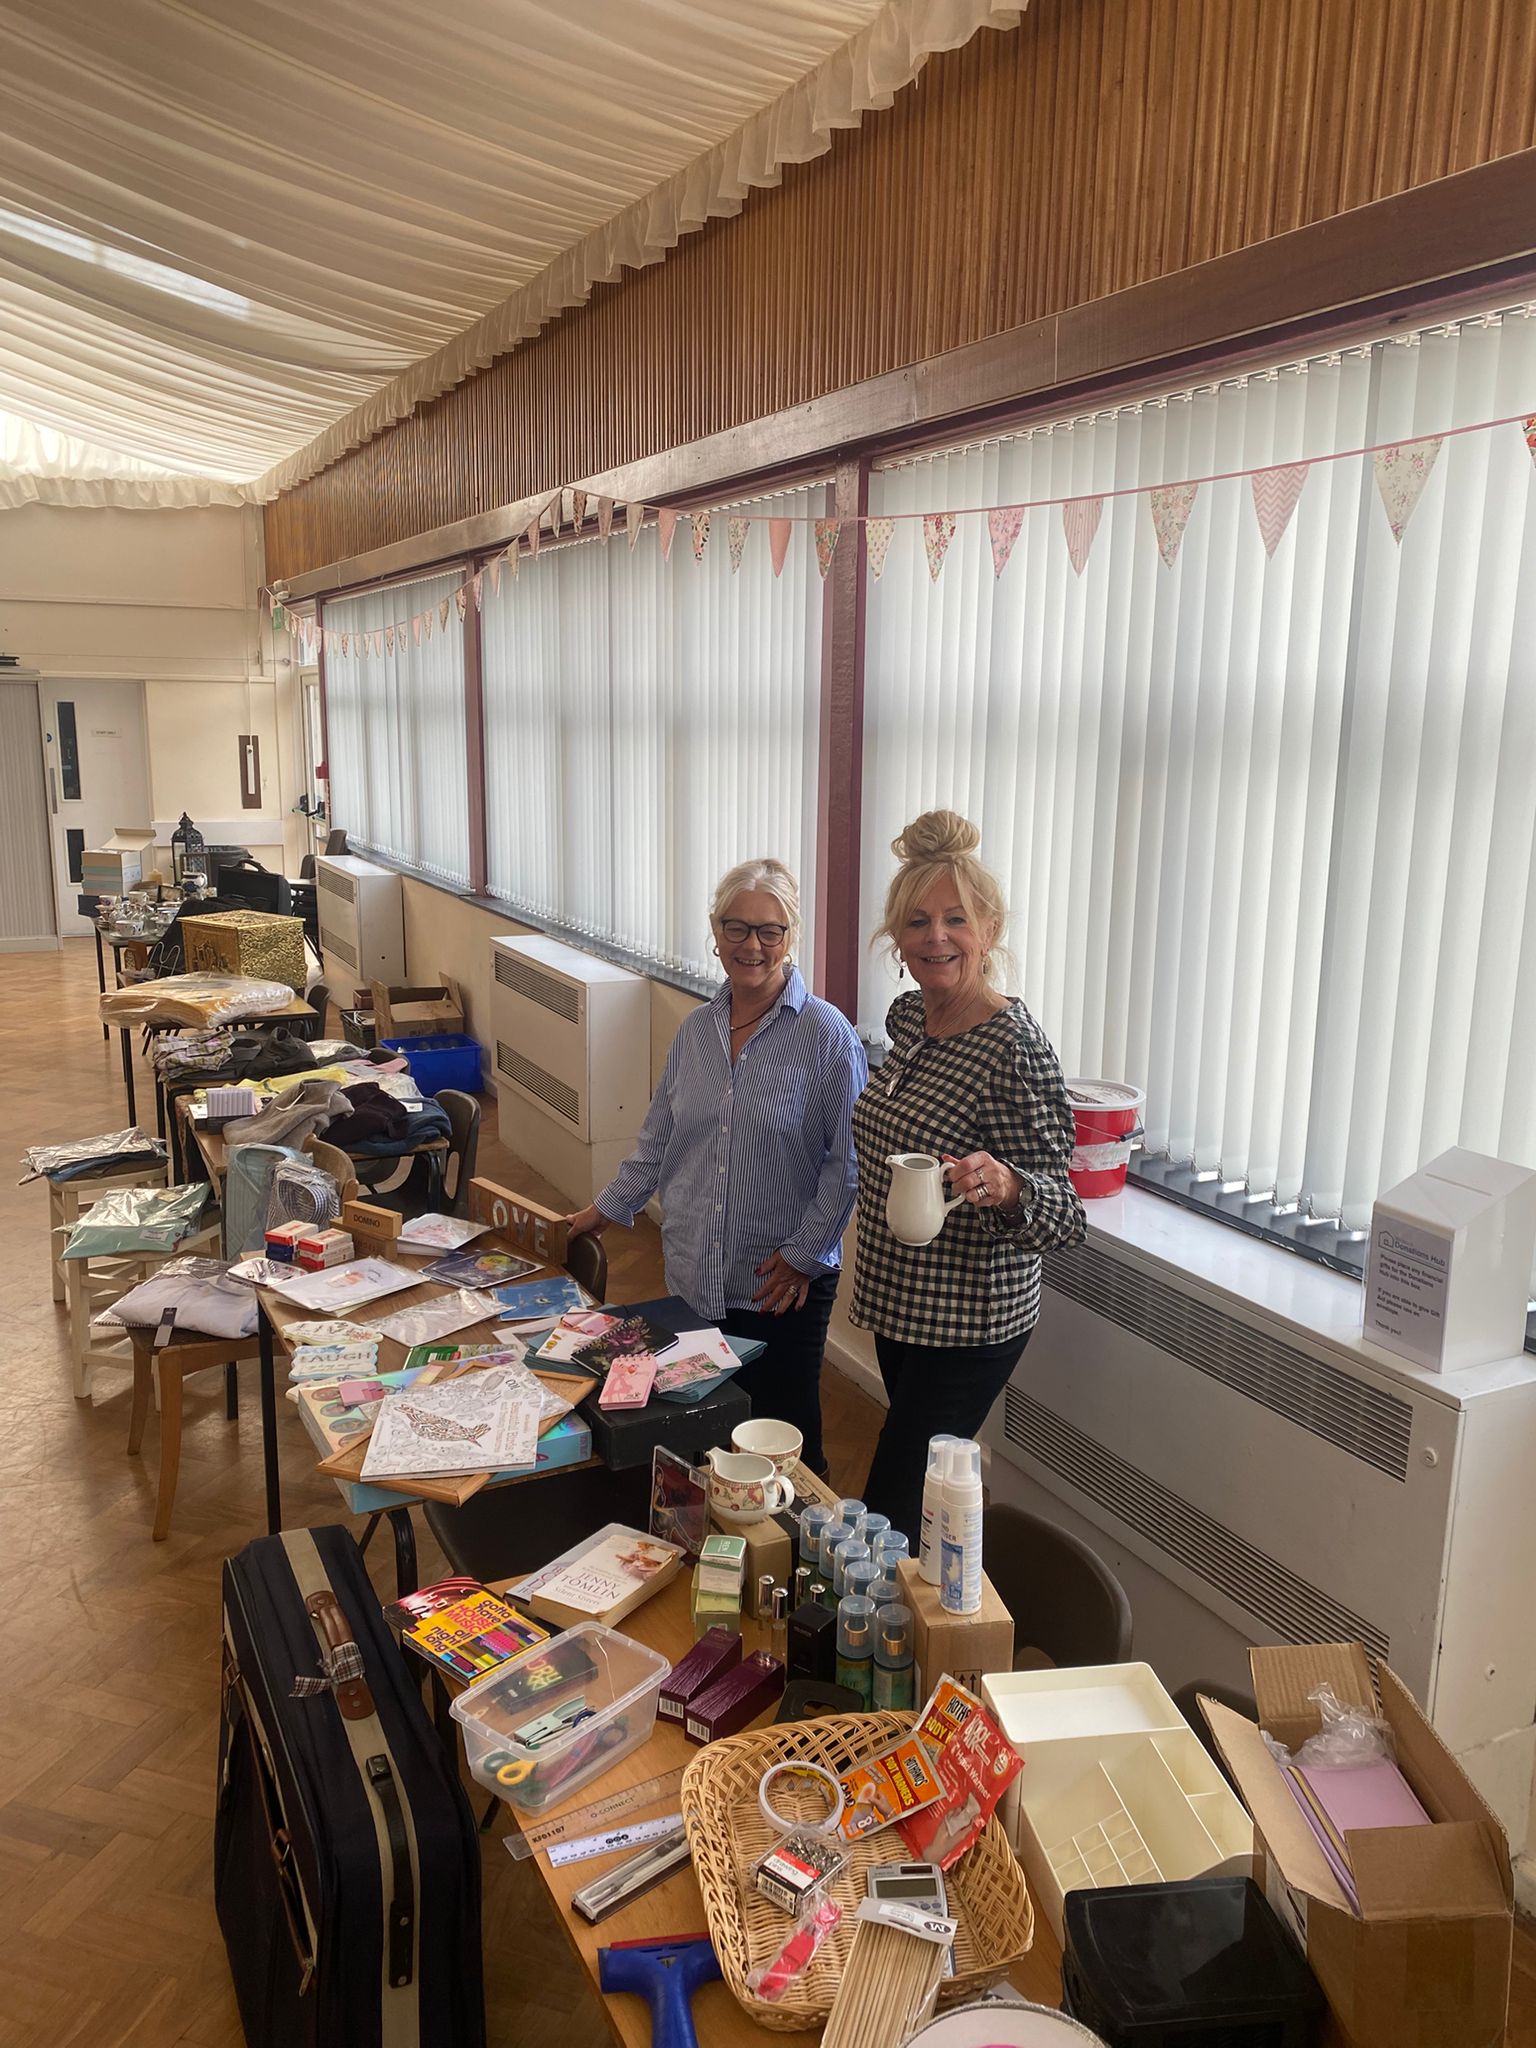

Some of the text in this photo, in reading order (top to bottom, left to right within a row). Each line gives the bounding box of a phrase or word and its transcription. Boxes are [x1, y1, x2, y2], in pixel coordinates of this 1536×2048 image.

[352, 1213, 380, 1229] DOMINO
[474, 1188, 550, 1258] LOVE
[1394, 1240, 1430, 1261] Donations
[1430, 1255, 1446, 1267] Hub
[1375, 1319, 1390, 1331] Thank
[301, 1352, 371, 1363] LAUGH
[561, 1575, 621, 1600] TOMLIN
[579, 1572, 618, 1590] JENNY
[454, 1603, 493, 1630] HOUSE
[474, 1603, 501, 1623] have
[481, 1599, 512, 1619] gotta
[444, 1609, 482, 1634] MUSIC
[423, 1633, 449, 1653] long
[430, 1626, 461, 1646] night
[454, 1628, 472, 1641] all
[903, 1755, 928, 1787] HOTHANDS
[956, 1749, 991, 1800] Hand Warmer
[885, 1756, 914, 1807] FOOT WARMERS
